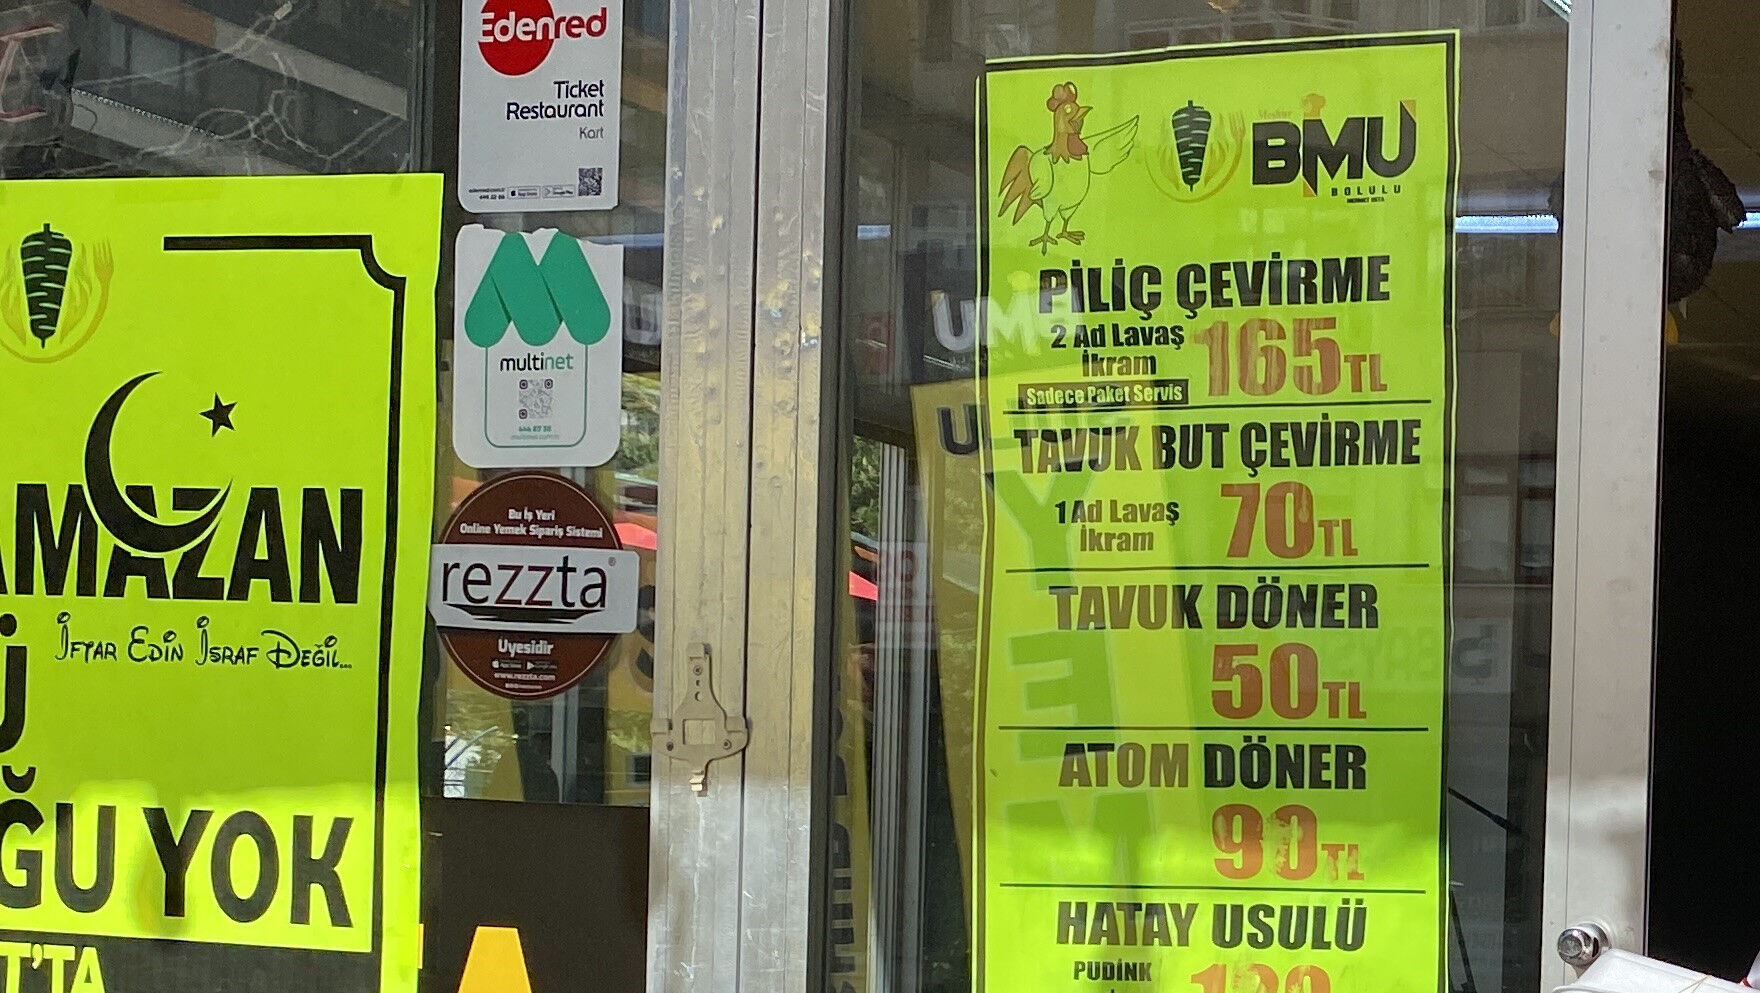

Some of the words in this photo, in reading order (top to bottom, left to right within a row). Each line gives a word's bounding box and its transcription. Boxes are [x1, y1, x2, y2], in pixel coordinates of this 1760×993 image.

[478, 6, 608, 43] Edenred
[553, 79, 605, 99] Ticket
[506, 99, 604, 121] Restaurant
[578, 126, 604, 140] Kart
[1331, 184, 1401, 197] BOLULU
[1039, 257, 1162, 320] PİLİÇ
[1176, 251, 1391, 319] ÇEVİRME
[1051, 324, 1067, 349] 2
[1073, 323, 1106, 348] Ad
[1111, 323, 1185, 351] Lavaş
[499, 351, 574, 372] multinet
[1082, 348, 1157, 377] İkram
[1026, 387, 1085, 406] Sadece
[1087, 385, 1130, 403] Paket
[1133, 383, 1183, 402] Servis
[1013, 424, 1145, 474] TAVUK
[1154, 423, 1230, 471] BUT
[1240, 412, 1422, 477] ÇEVİRME
[508, 508, 522, 520] Bu
[535, 509, 556, 521] Yeri
[1071, 501, 1101, 524] Ad
[1109, 499, 1180, 527] Lavaş
[0, 483, 363, 604] MAZAN
[459, 522, 491, 534] Online
[493, 523, 527, 536] Yemek
[529, 524, 564, 539] Sipariş
[565, 525, 603, 539] Sistemi
[1080, 525, 1154, 553] İkram
[441, 554, 608, 609] rezzta
[1048, 583, 1204, 631] TAVUK
[1215, 576, 1379, 630] DÖNER
[1057, 742, 1190, 789] ATOM
[1203, 735, 1368, 790] DÖNER
[142, 806, 355, 930] YOK
[1055, 900, 1199, 948] HATAY
[1211, 898, 1368, 952] USULÜ
[1073, 958, 1153, 982] PUDİNK
